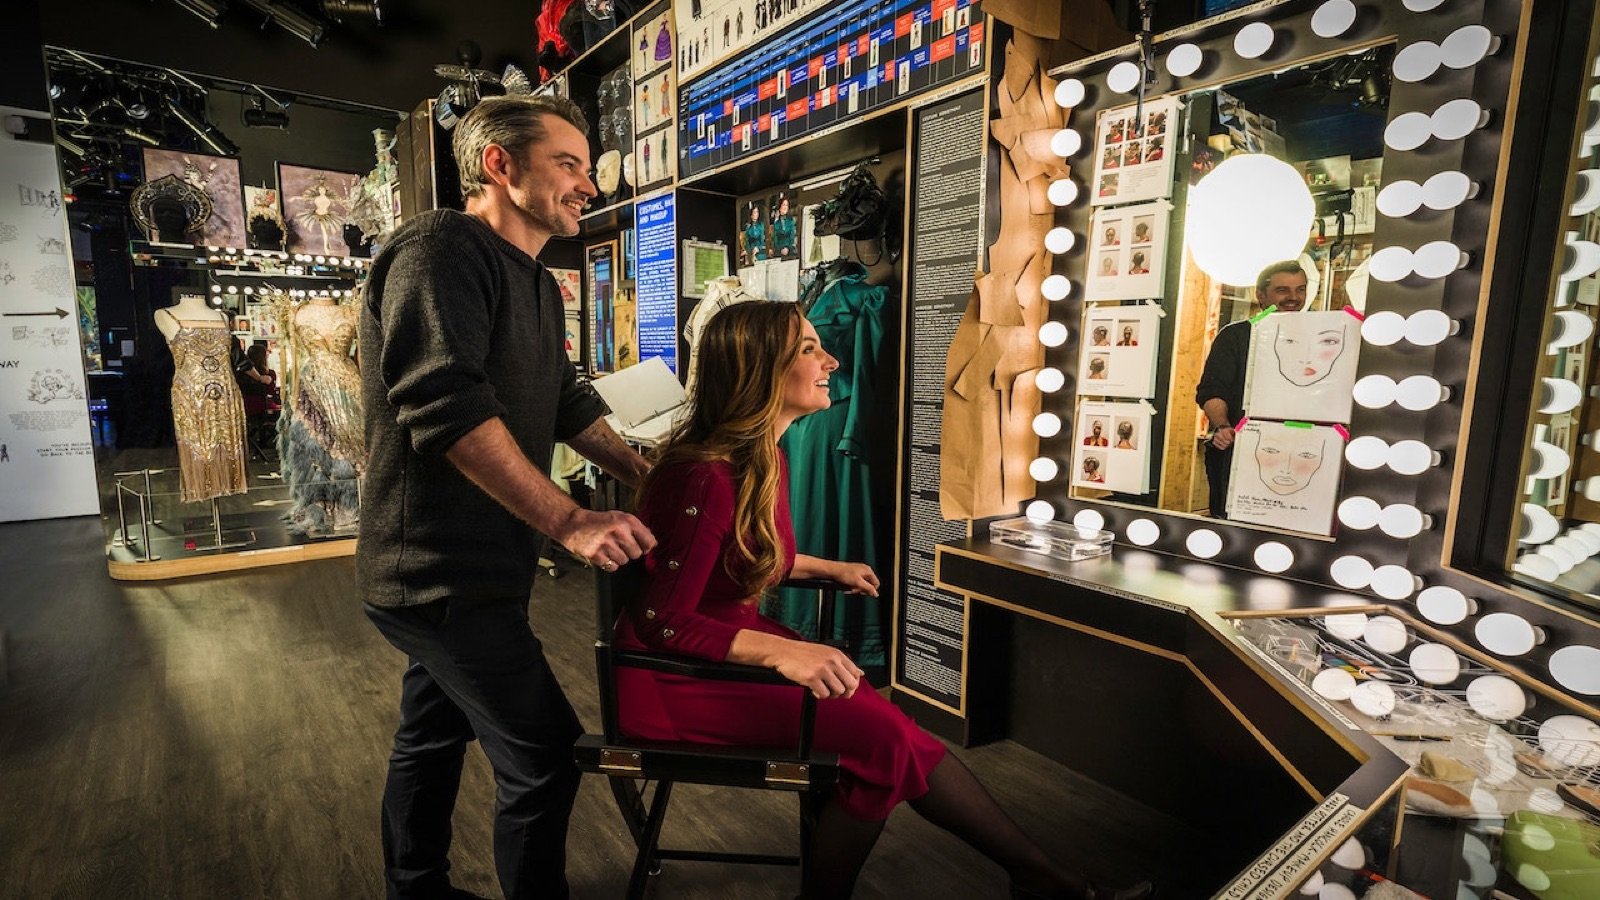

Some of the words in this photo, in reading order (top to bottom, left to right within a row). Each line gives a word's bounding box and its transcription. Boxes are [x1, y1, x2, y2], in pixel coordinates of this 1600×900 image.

[639, 214, 649, 224] AND
[1301, 811, 1327, 831] POTTER
[1290, 831, 1306, 843] AND
[1275, 842, 1292, 855] THE
[1249, 852, 1280, 880] CURSED
[1228, 878, 1252, 898] CHILD
